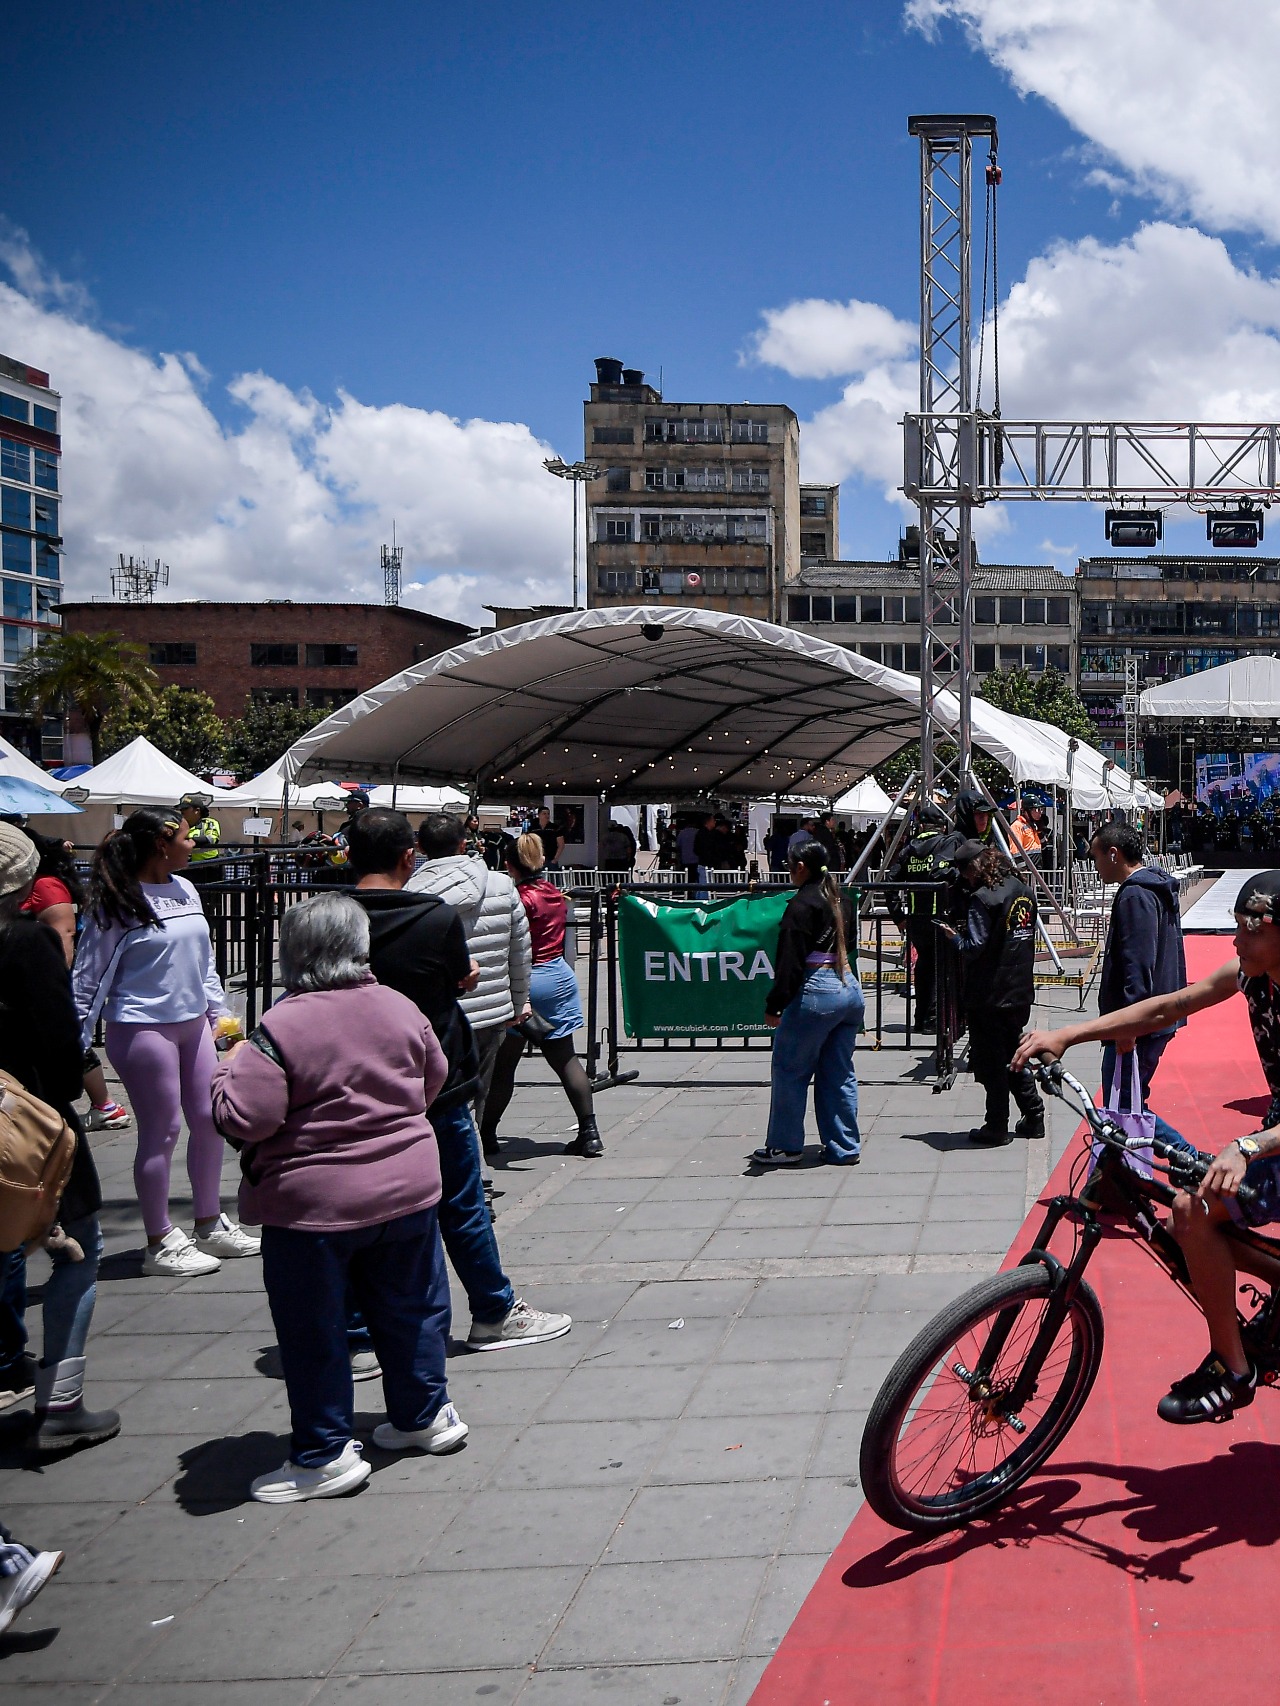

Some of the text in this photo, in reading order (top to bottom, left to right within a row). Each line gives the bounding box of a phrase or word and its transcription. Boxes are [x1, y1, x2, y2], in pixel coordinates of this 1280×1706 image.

[907, 863, 934, 873] PEOPL
[644, 950, 775, 982] ENTRA
[653, 1024, 729, 1032] www.ecubick.com
